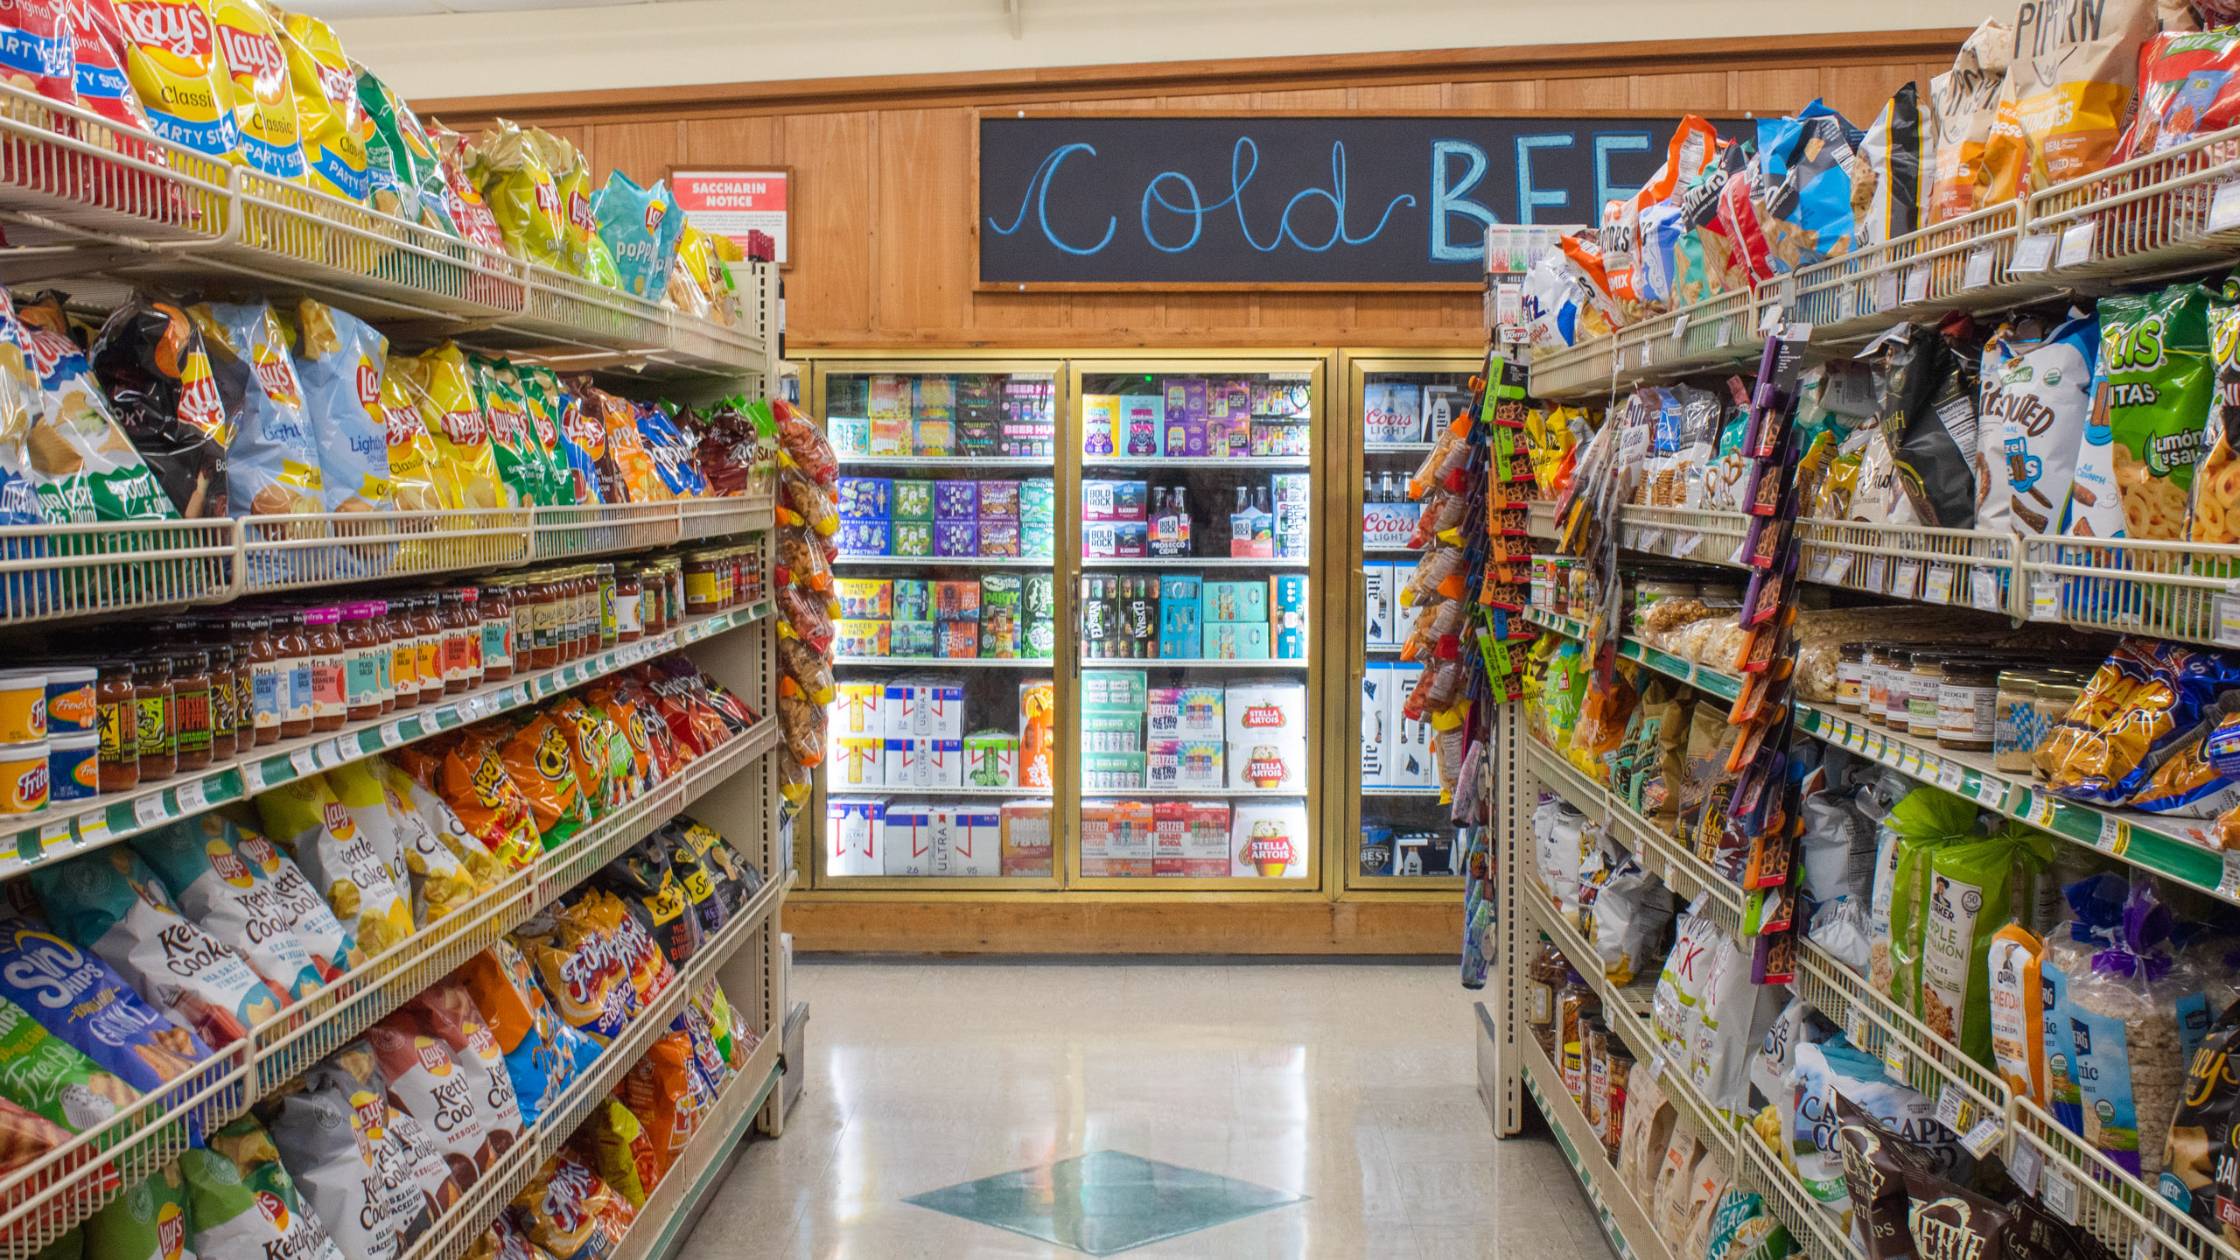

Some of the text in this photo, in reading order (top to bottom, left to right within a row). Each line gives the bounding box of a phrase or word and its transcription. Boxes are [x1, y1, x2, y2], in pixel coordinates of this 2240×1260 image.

[118, 2, 208, 59] Lay's
[220, 26, 281, 80] Lay's
[252, 113, 294, 135] Classic
[149, 117, 237, 151] PARTY SIZ
[243, 141, 287, 169] PARTY
[328, 159, 359, 191] PARTY
[692, 182, 766, 195] SACCHARIN
[706, 195, 753, 208] NOTICE
[988, 135, 1416, 253] Cold
[1429, 131, 1652, 262] BEE
[1366, 407, 1413, 426] Coors
[1370, 426, 1408, 435] LIGHT
[1089, 489, 1111, 498] BOLD
[1089, 497, 1111, 507] ROCK
[1159, 519, 1176, 528] BOLD
[1233, 522, 1250, 530] BOLD
[1363, 512, 1415, 533] Coors
[1091, 530, 1113, 540] BOLD
[1159, 527, 1176, 535] ROCK
[1233, 529, 1250, 537] ROCK
[1373, 532, 1405, 542] LIGHT
[1091, 539, 1113, 549] ROCK
[1151, 541, 1186, 550] PROSECCO
[1249, 709, 1278, 718] STELLA
[1152, 716, 1178, 726] RETRO
[1249, 716, 1279, 725] ARTOIS
[1151, 767, 1177, 776] RETRO
[1251, 762, 1281, 771] STELLA
[1251, 769, 1282, 777] ARTOIS
[18, 766, 49, 801] Frito
[1157, 821, 1185, 833] SELTZER
[938, 827, 948, 872] ULTRA
[1251, 841, 1289, 851] STELLA
[1251, 850, 1290, 860] ARTOIS
[1361, 851, 1391, 862] BEST
[237, 887, 279, 918] Kettl
[1931, 902, 1956, 924] UAKER
[245, 912, 290, 945] Cook
[157, 920, 201, 960] Ket
[166, 939, 236, 977] Cooke
[429, 1071, 471, 1113] Kettl
[1802, 1095, 1837, 1127] CA
[446, 1121, 481, 1144] MESQUI
[157, 1212, 184, 1254] Lay's
[367, 1239, 392, 1257] CRACKE
